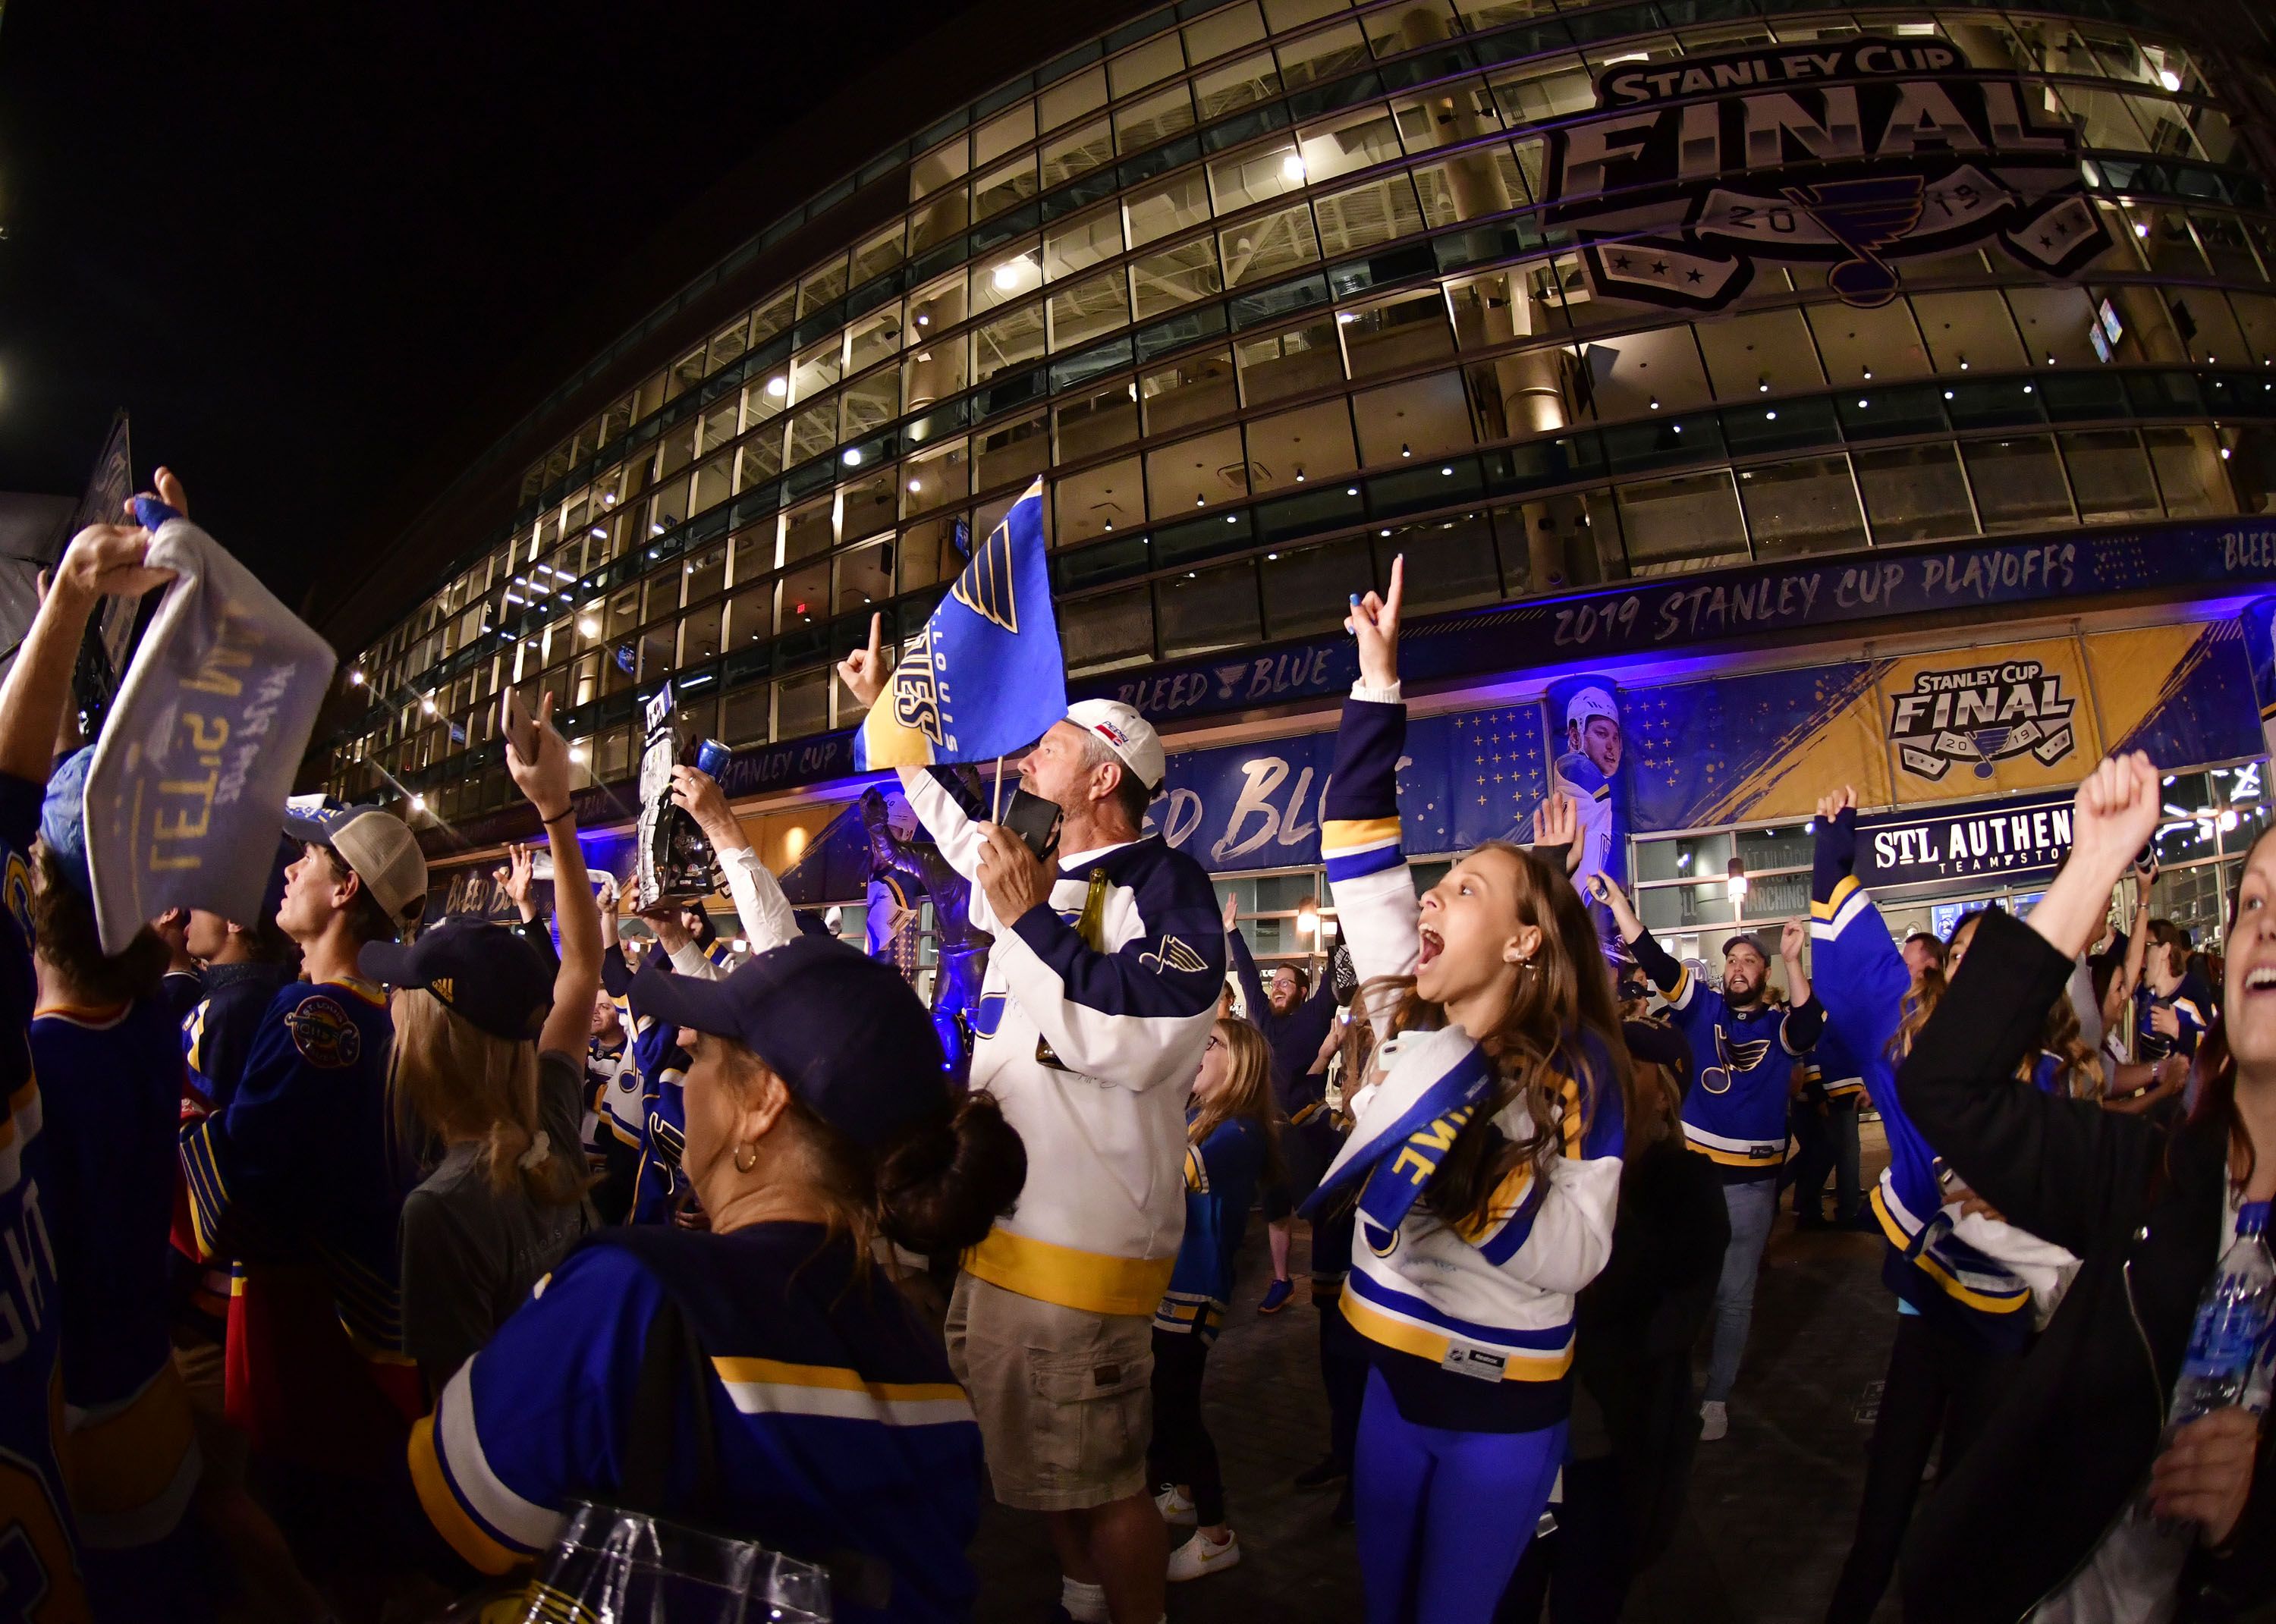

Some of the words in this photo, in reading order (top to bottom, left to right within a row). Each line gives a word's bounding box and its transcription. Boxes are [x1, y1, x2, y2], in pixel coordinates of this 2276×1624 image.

[1611, 52, 1842, 105] STANLEY
[1855, 46, 1954, 74] CUP
[1560, 80, 2068, 211] FINAL
[2222, 532, 2276, 571] BLEE
[1555, 596, 1639, 646] 2019
[1655, 573, 1820, 640] STANLEY
[1836, 562, 1904, 608] CUP
[1922, 543, 2076, 598] PLAYOFFS
[1245, 646, 1334, 701] BLUE
[1918, 669, 1998, 693] STANLEY
[2001, 665, 2039, 683] CUP
[1894, 680, 2070, 733] FINAL
[1102, 721, 1129, 743] PEPSI
[1946, 738, 1967, 751] 20
[2014, 729, 2030, 743] 19
[799, 742, 838, 775] CUP
[1875, 828, 1938, 869] STL
[1949, 809, 2076, 860] AUTHEN
[1939, 856, 2000, 874] TEAM
